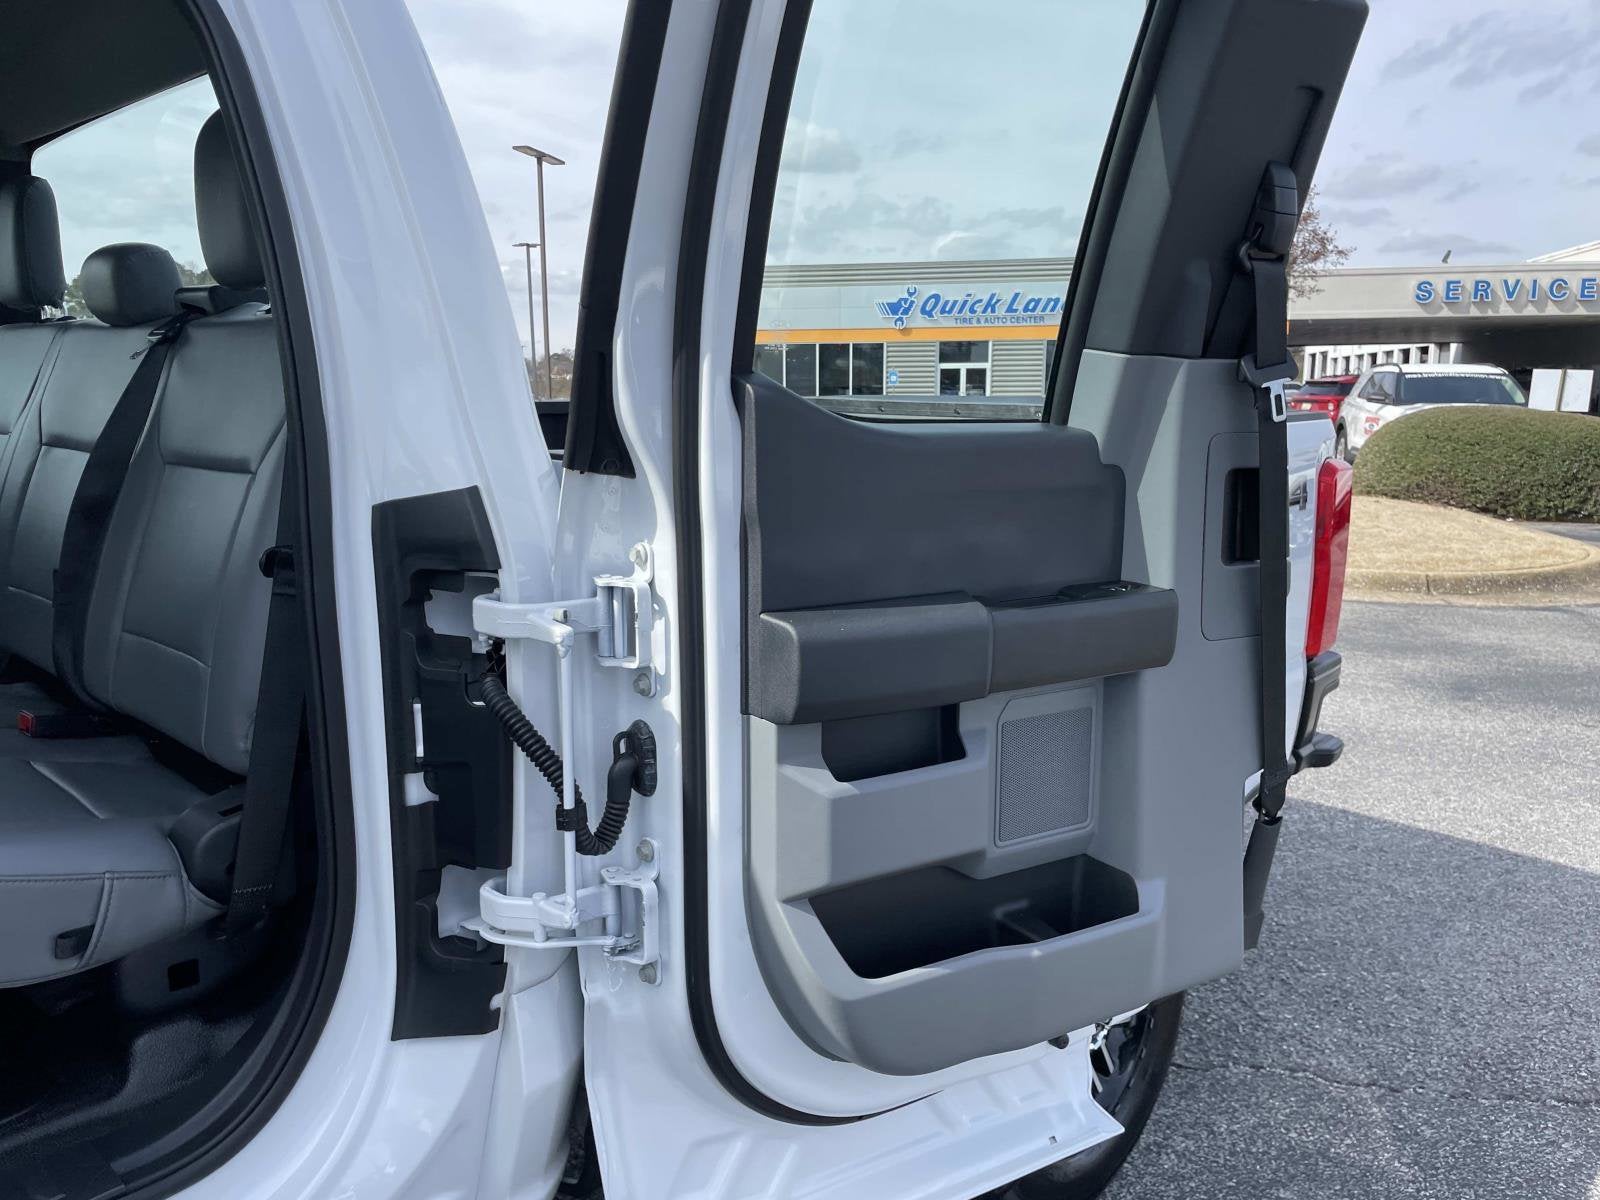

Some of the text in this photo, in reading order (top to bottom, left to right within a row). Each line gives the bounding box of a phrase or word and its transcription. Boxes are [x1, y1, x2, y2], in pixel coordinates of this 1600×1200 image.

[1415, 277, 1598, 303] SERVICE
[920, 291, 1066, 319] Quick Lan
[954, 315, 1045, 326] TIRE & AUTO CENTER
